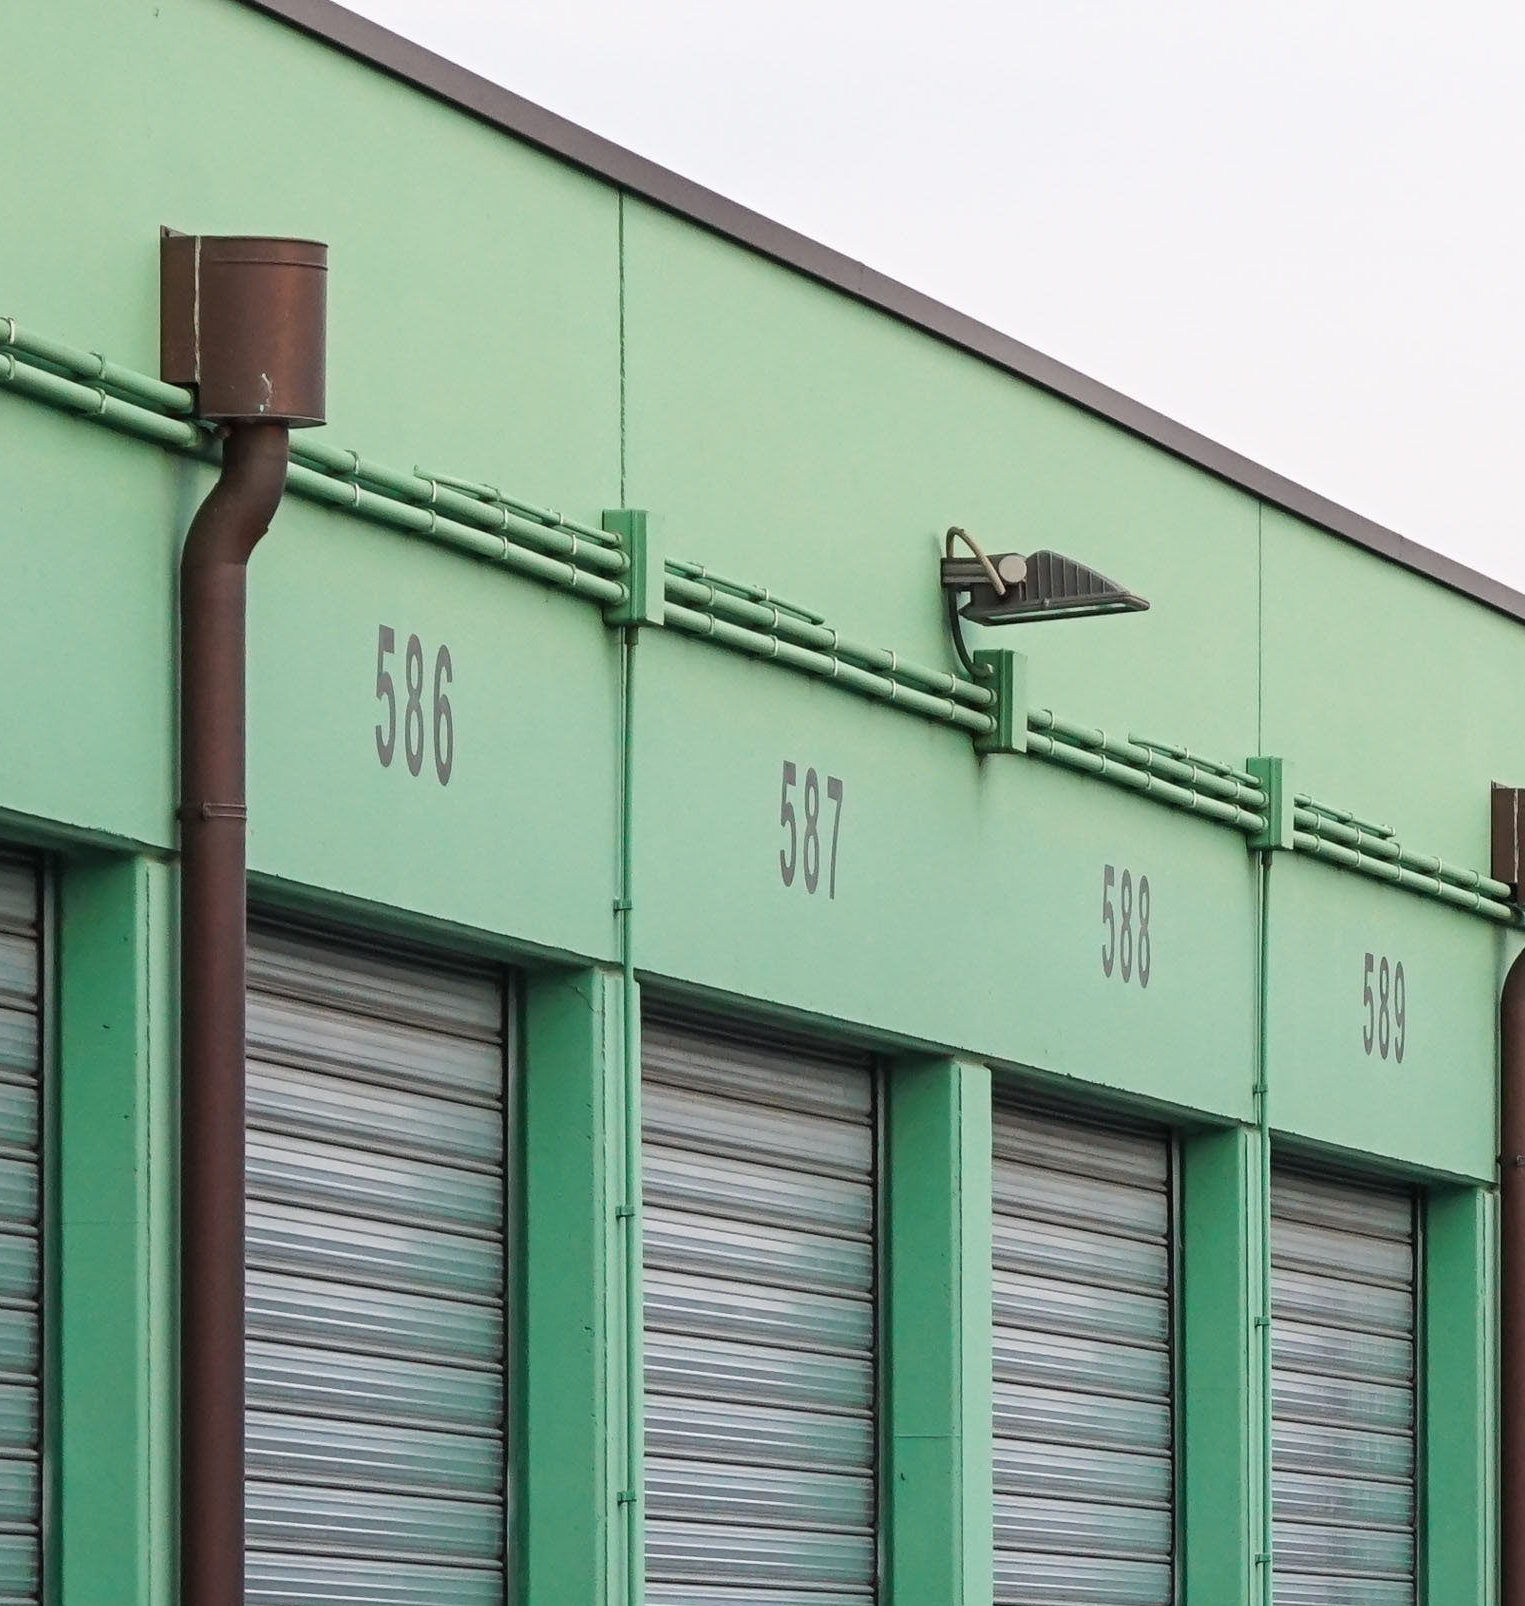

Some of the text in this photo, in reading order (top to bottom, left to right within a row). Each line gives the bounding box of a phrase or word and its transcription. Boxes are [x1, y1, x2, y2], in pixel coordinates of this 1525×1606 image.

[375, 623, 454, 787] 586
[779, 759, 843, 901] 587
[1101, 863, 1151, 990] 588
[1362, 952, 1406, 1065] 589
